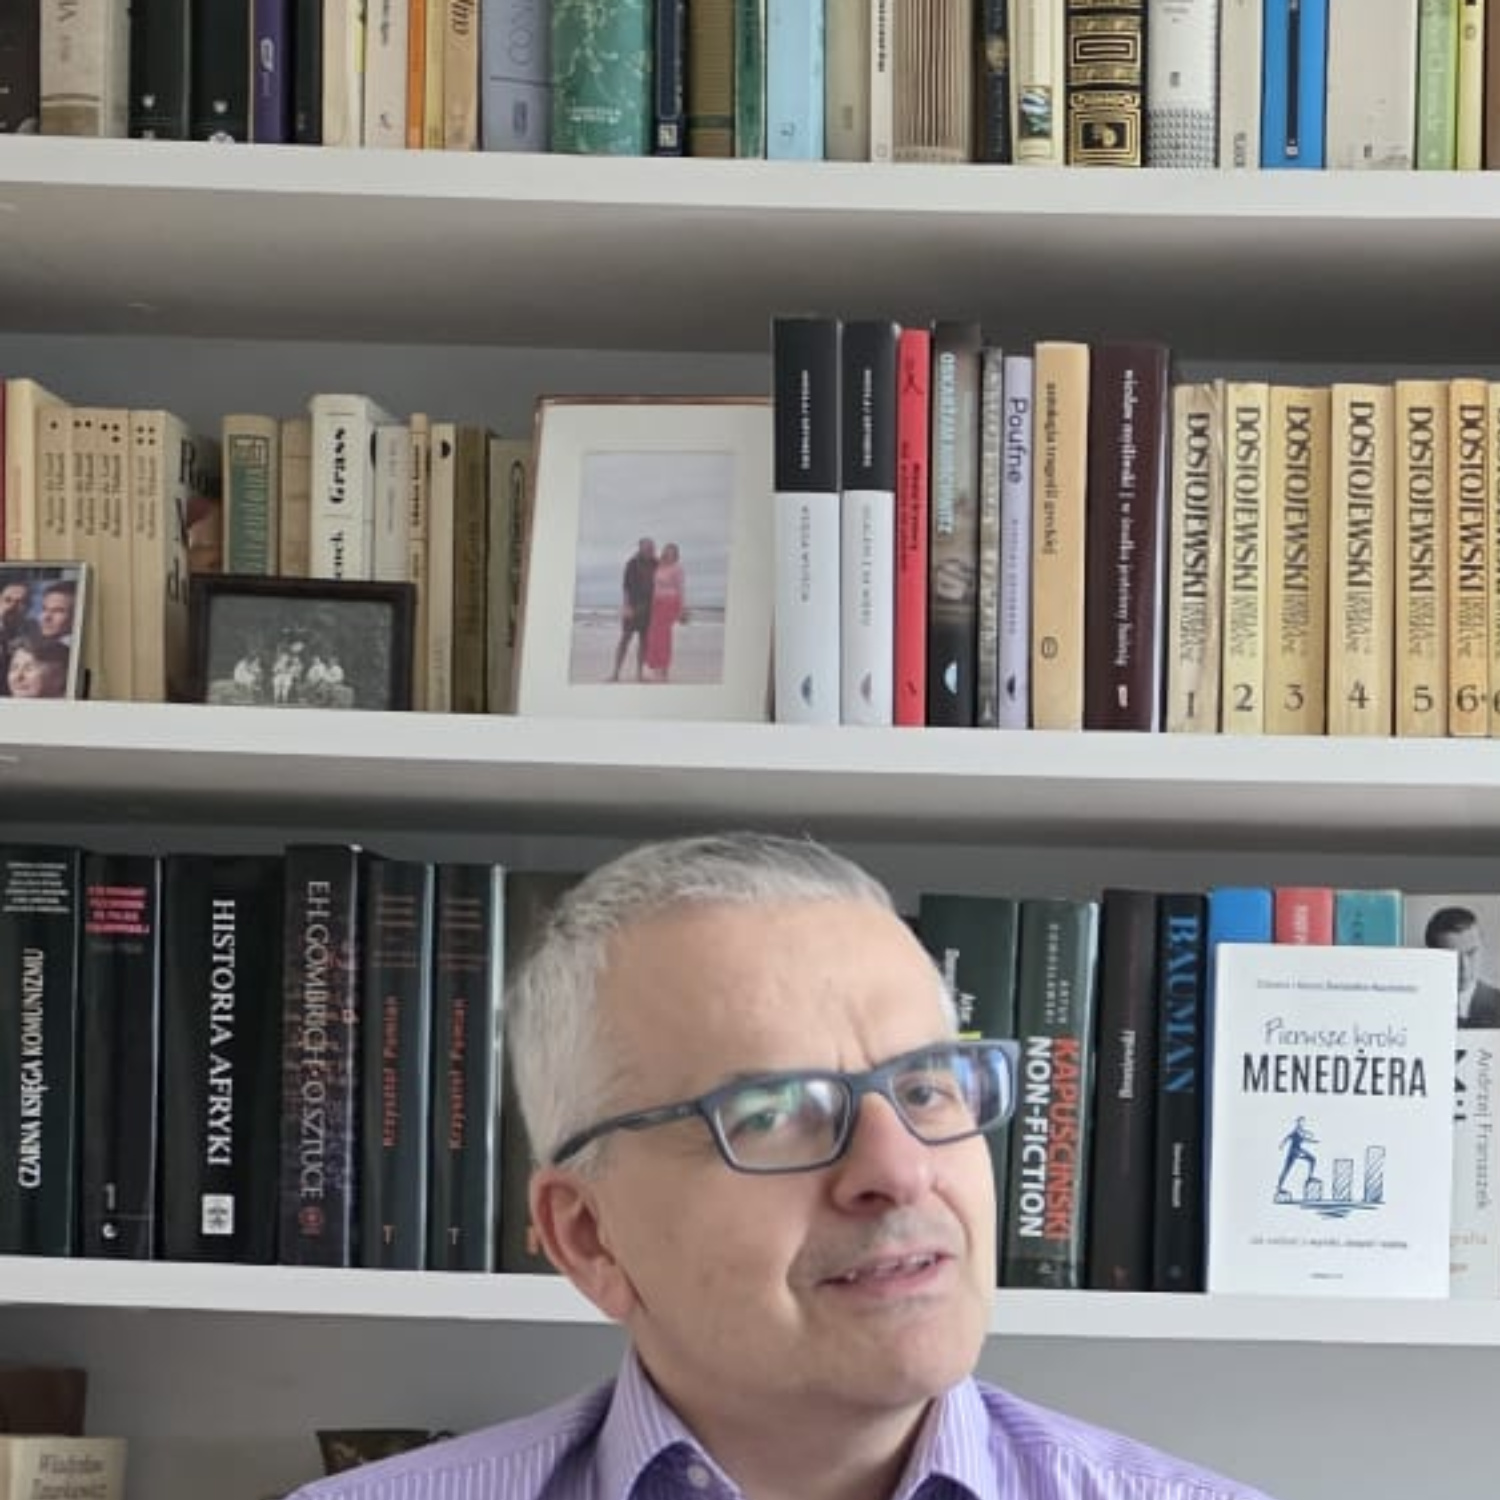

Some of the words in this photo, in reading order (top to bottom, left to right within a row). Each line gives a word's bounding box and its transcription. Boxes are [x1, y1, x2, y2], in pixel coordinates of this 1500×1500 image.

[1005, 397, 1028, 485] Poufne
[1182, 411, 1210, 598] DOSTOJEWSKI
[1232, 406, 1261, 592] DOSTOJEWSKI
[1283, 404, 1312, 592] DOSTOJEWSKI
[1346, 401, 1375, 589] DOSTOJEWSKI
[1408, 406, 1435, 593] DOSTOJEWSKI
[1459, 404, 1485, 593] DOSTOJEWSKI
[1234, 684, 1255, 712] 2
[1284, 684, 1304, 712] 3
[1348, 680, 1370, 710] 4
[1413, 685, 1434, 713] 5
[22, 947, 45, 1056] KOMUNIZMU
[209, 900, 236, 1057] HISTORIA
[304, 923, 329, 1065] GOMBRICH
[1164, 914, 1198, 1094] BAUMAN
[1242, 1049, 1428, 1098] MENEDŻERA
[1264, 1016, 1347, 1049] Pierwsze
[1353, 1023, 1409, 1049] kroki
[1474, 1048, 1493, 1118] Andrzej
[21, 1060, 47, 1117] KSIĘGA
[207, 1059, 235, 1166] AFRYKI
[1018, 1035, 1052, 1238] NON-FICTION
[18, 1122, 43, 1188] CZARNA
[299, 1108, 325, 1199] SZTUCE
